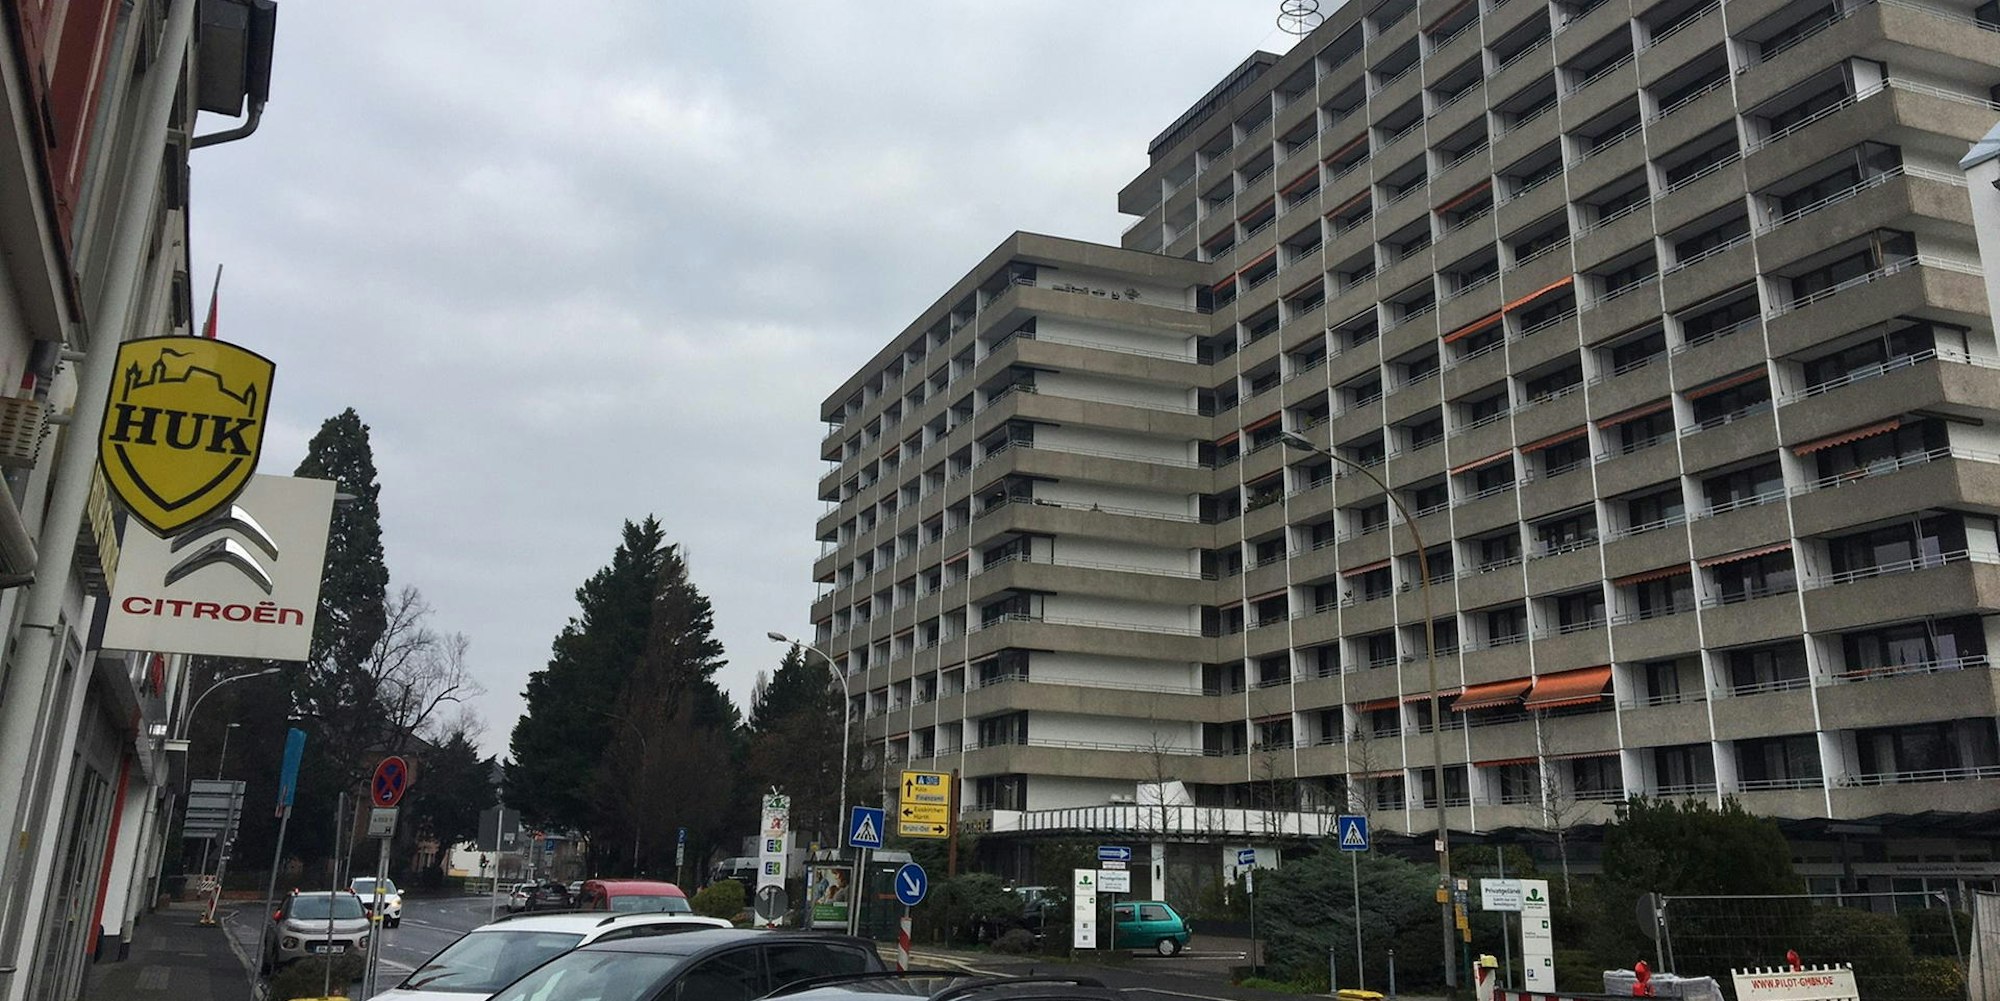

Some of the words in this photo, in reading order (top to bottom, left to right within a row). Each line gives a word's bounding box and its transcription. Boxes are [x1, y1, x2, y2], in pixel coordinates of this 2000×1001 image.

[109, 403, 256, 456] HUK
[122, 597, 303, 626] CITROËN
[913, 806, 944, 814] Euskirchen
